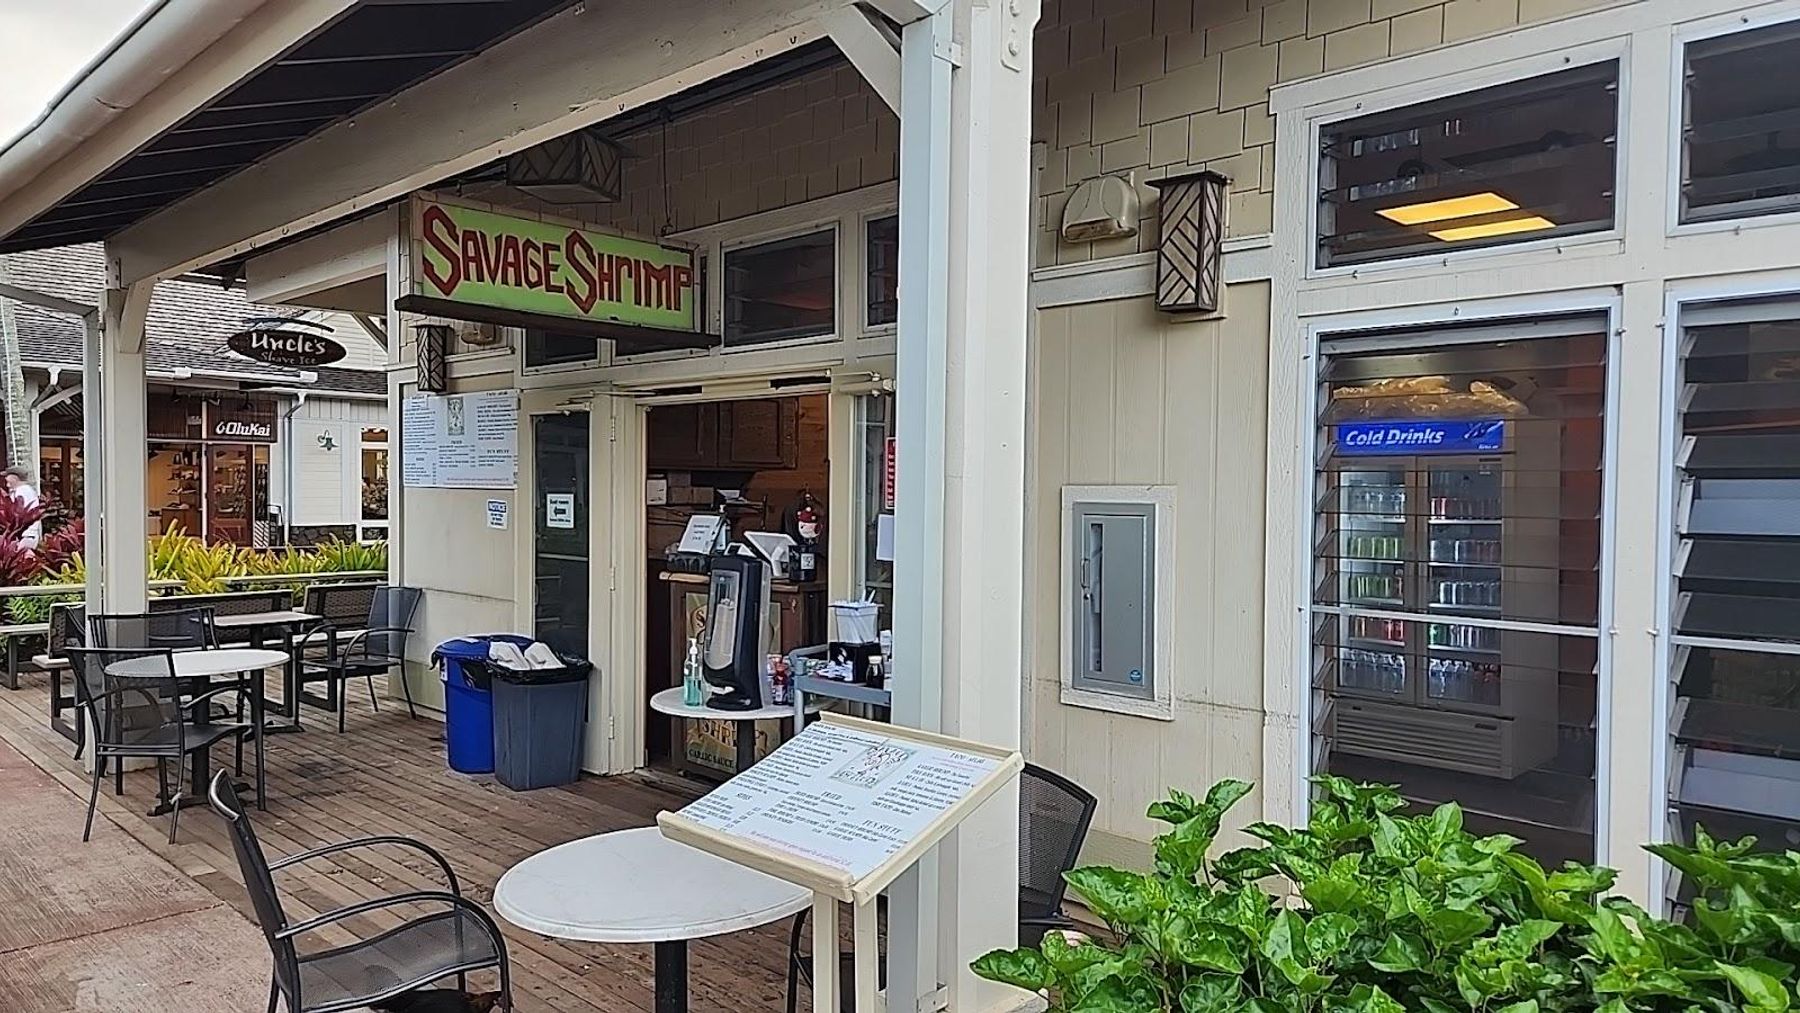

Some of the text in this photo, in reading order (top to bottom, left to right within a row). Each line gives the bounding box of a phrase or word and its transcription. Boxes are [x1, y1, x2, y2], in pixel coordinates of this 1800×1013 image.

[422, 204, 692, 314] SAVAGE SHRIMP
[251, 331, 326, 355] Uncle's
[261, 351, 317, 365] Shave Ice
[225, 421, 271, 437] OluKai
[1346, 427, 1445, 446] Cold Drinks
